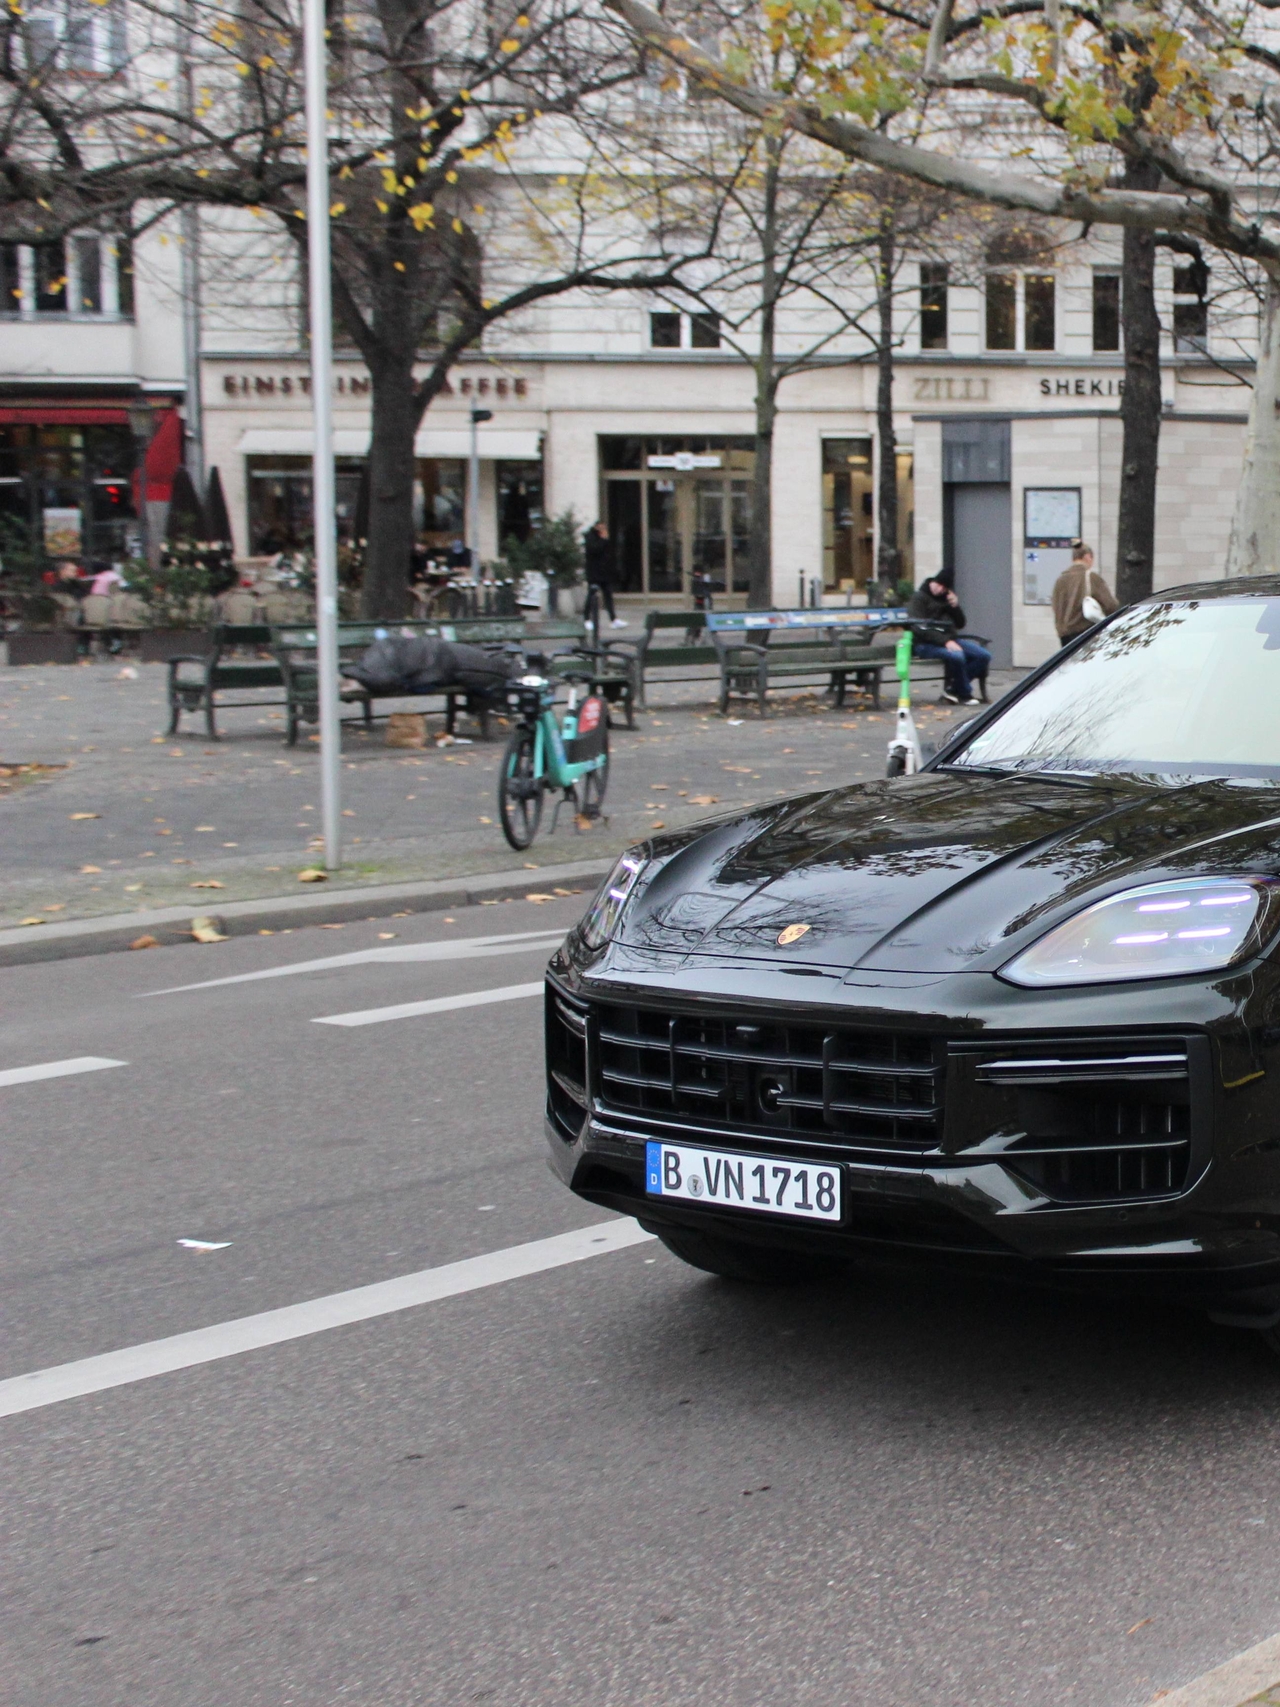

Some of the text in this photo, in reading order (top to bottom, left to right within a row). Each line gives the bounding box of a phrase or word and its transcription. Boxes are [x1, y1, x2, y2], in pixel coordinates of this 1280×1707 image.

[223, 376, 371, 395] EINSTIN
[914, 377, 990, 400] ZILLI
[663, 1150, 682, 1190] B
